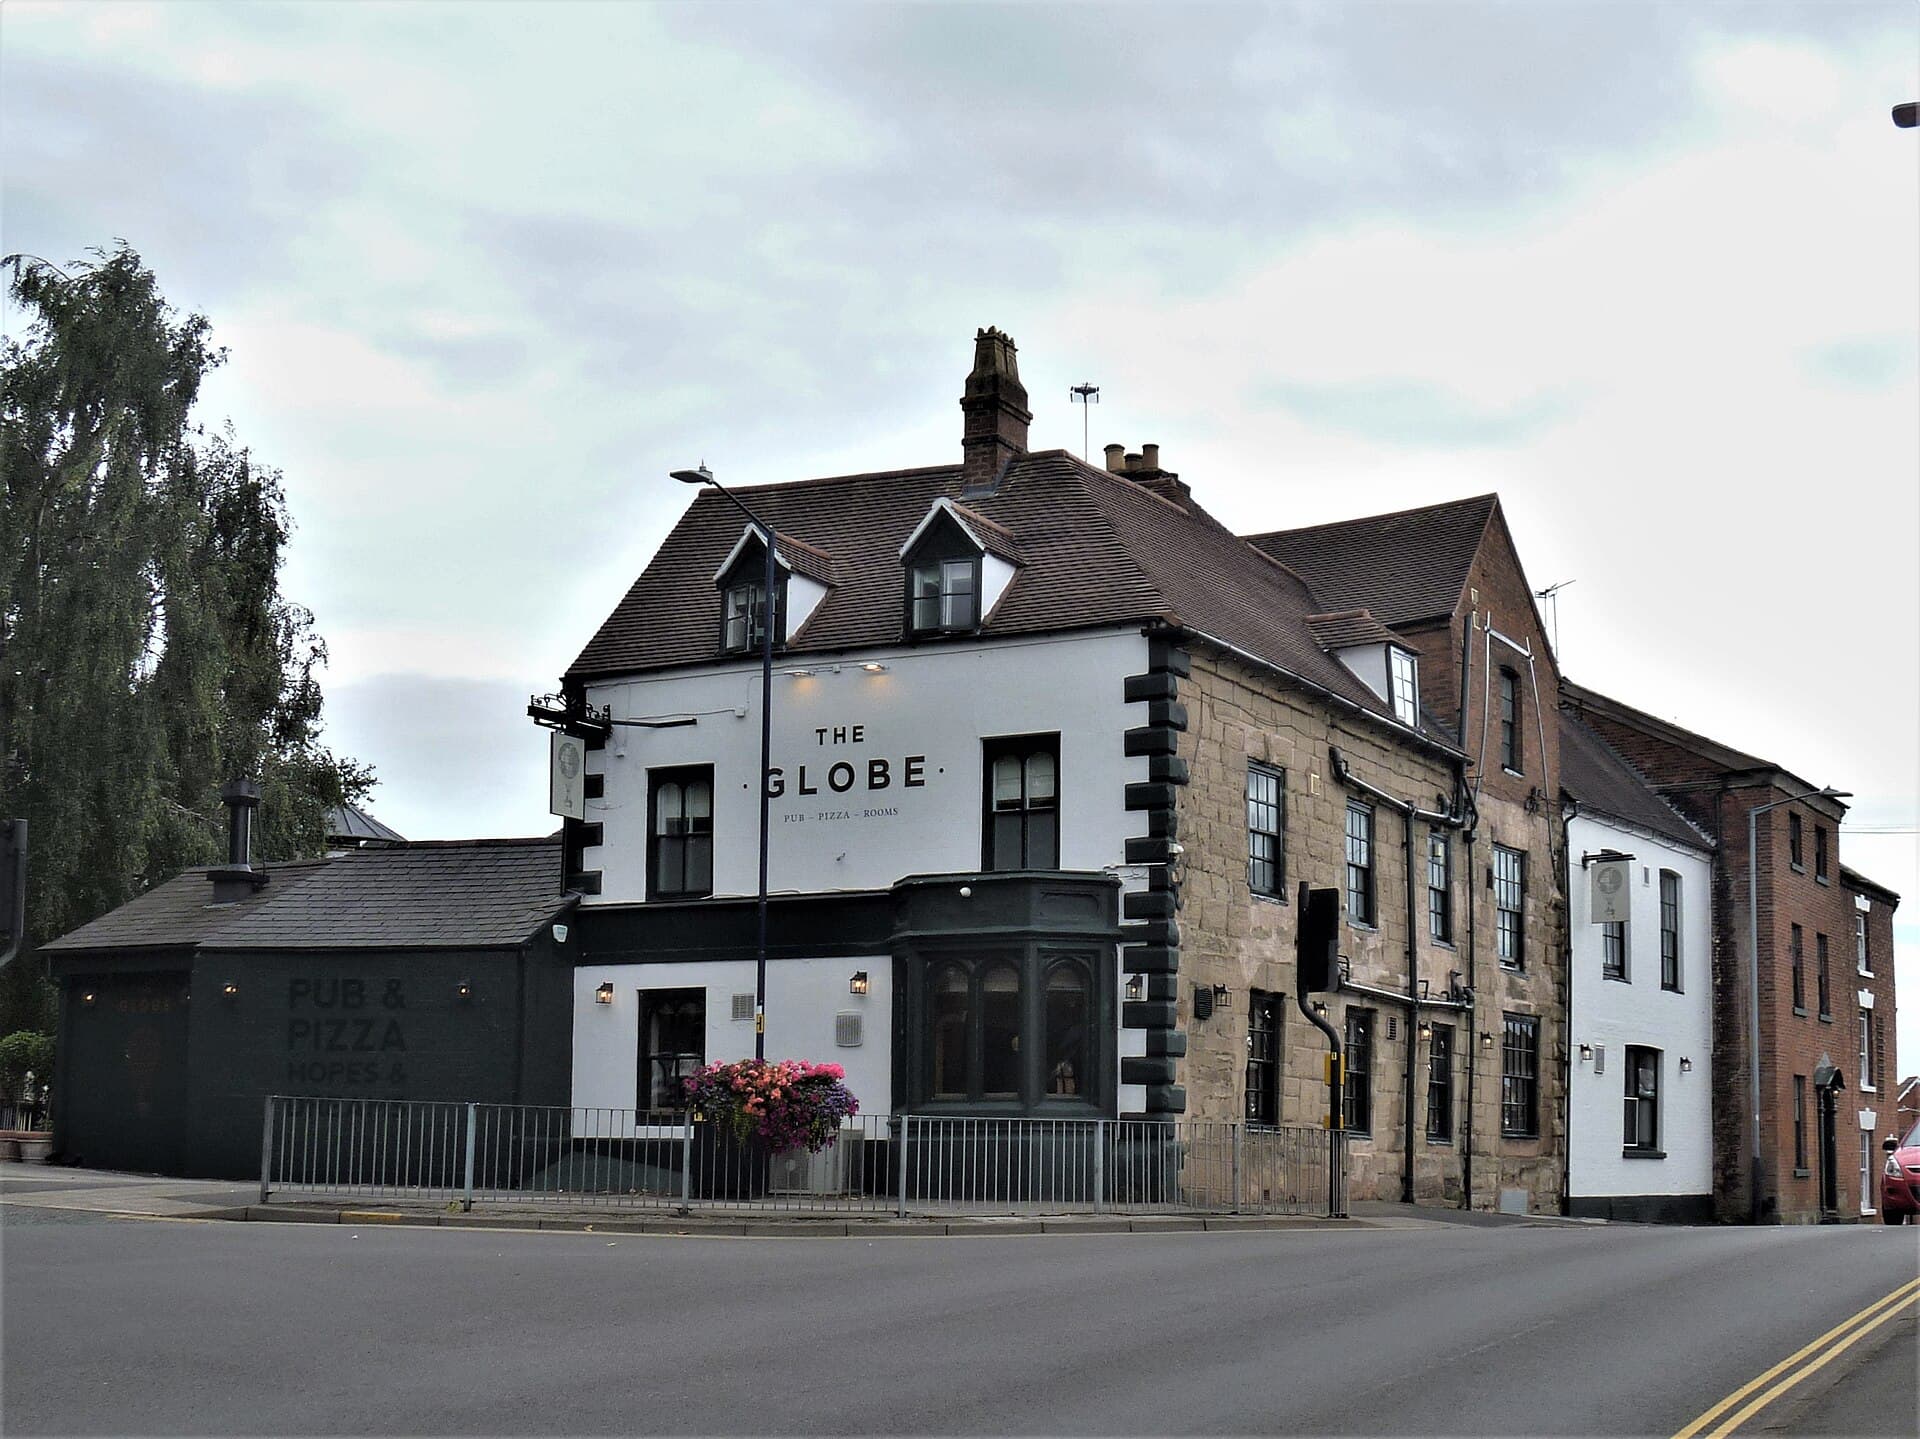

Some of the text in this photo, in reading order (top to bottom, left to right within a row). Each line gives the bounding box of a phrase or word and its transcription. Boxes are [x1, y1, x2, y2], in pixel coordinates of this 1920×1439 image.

[816, 725, 865, 745] THE
[768, 756, 926, 798] GLOBE
[784, 807, 898, 823] PUB PIZZA ROOMS
[289, 978, 407, 1009] PUB &
[288, 1018, 407, 1051] PIZZA
[288, 1061, 407, 1084] HOPES &
